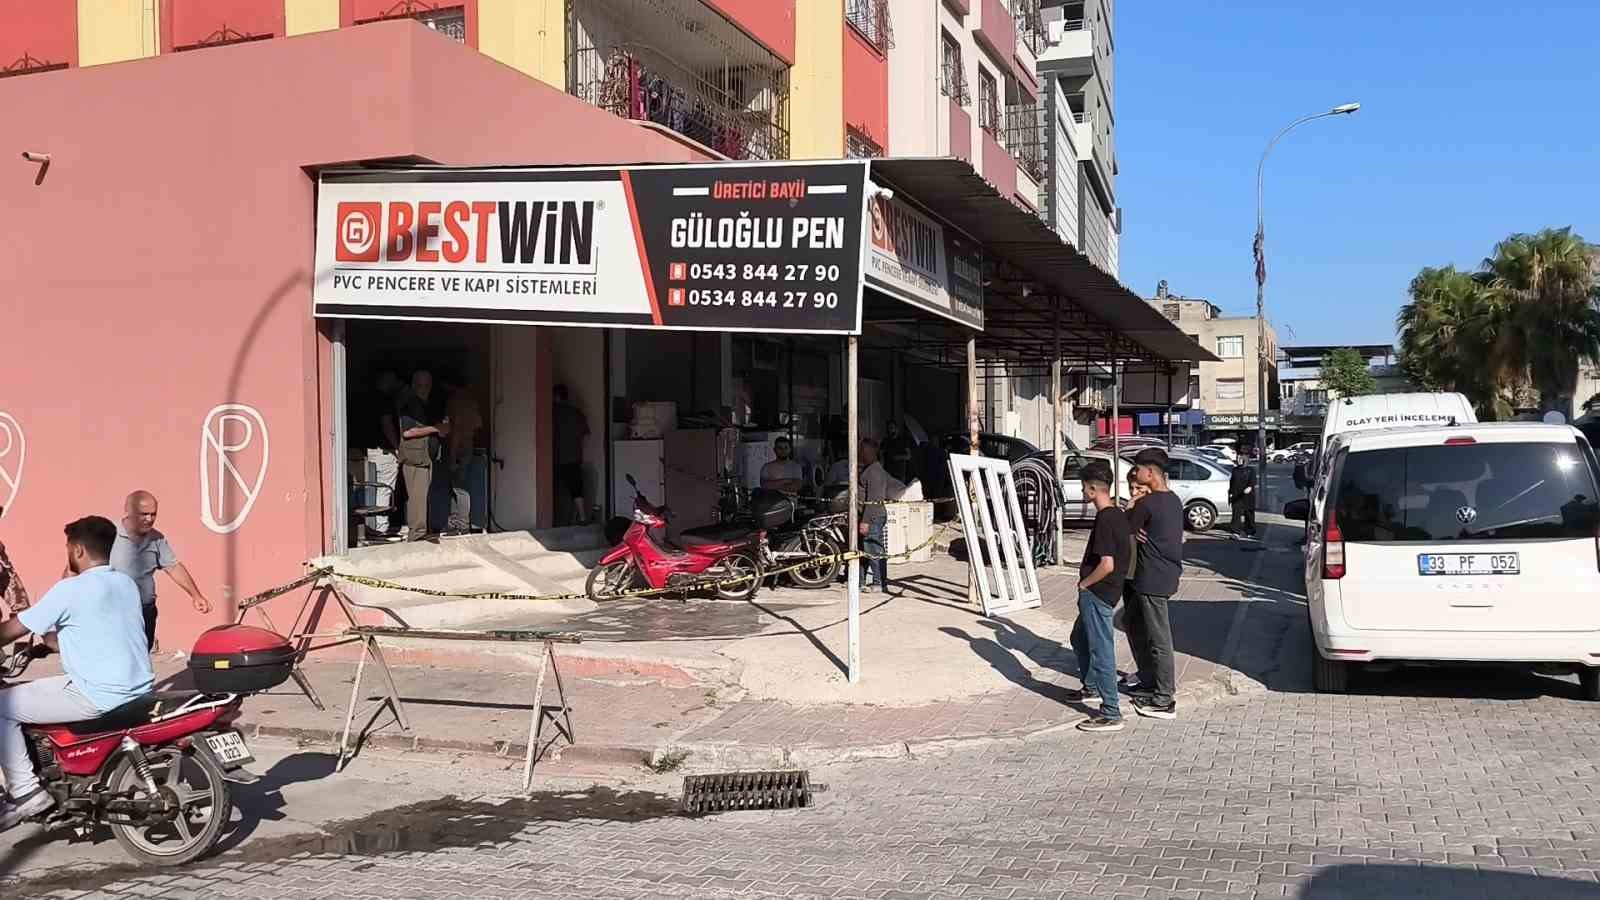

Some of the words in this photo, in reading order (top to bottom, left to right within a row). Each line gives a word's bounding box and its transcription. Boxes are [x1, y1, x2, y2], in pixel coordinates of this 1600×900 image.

[713, 180, 766, 199] ÜRETİCİ
[770, 179, 805, 198] BAYİİ
[671, 211, 783, 248] GÜLOĞLU
[791, 217, 845, 248] PEN
[690, 263, 737, 280] 0543
[742, 264, 778, 280] 844
[784, 265, 808, 281] 27
[814, 265, 840, 282] 90
[333, 275, 362, 289] PVC
[367, 276, 435, 291] PENCERE
[441, 277, 460, 292] VE
[465, 278, 500, 293] KAPI
[506, 275, 597, 296] SİSTEMLERİ
[688, 289, 736, 306] 0534
[741, 291, 778, 307] 844
[783, 292, 808, 308] 27
[813, 292, 838, 309] 90
[1346, 417, 1372, 426] OLAY
[1374, 414, 1398, 423] YERİ
[1429, 556, 1446, 570] 33
[1459, 555, 1476, 570] PF
[1490, 555, 1517, 570] 052
